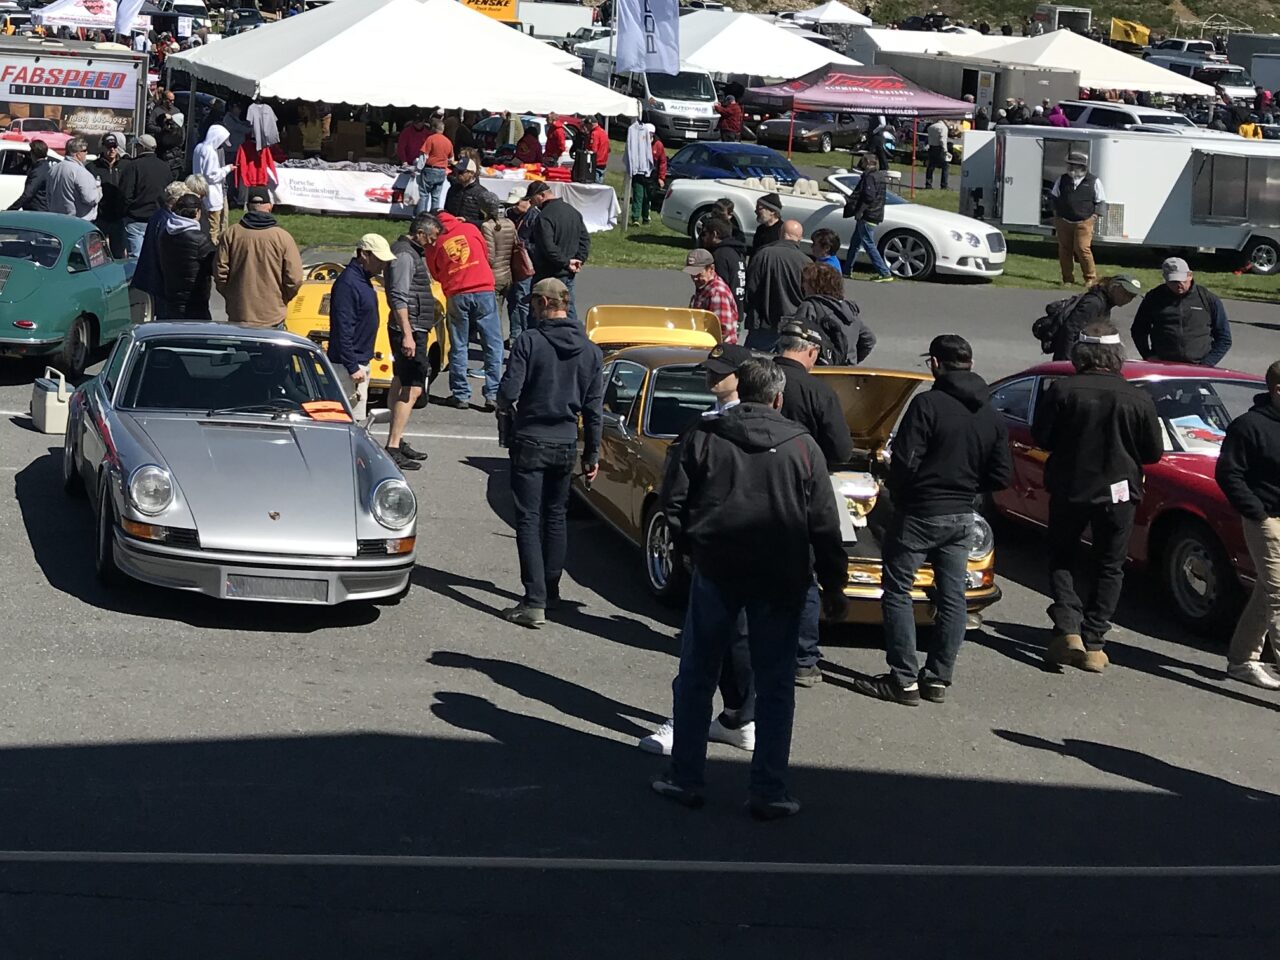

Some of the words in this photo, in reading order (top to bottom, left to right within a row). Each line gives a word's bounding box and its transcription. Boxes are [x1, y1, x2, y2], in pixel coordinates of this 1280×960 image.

[0, 64, 127, 89] FABSPEED
[10, 85, 108, 99] MOTORSPORT
[824, 85, 872, 94] ALUMINUM
[289, 178, 315, 187] Porsche
[289, 185, 340, 195] Mechanicsburg
